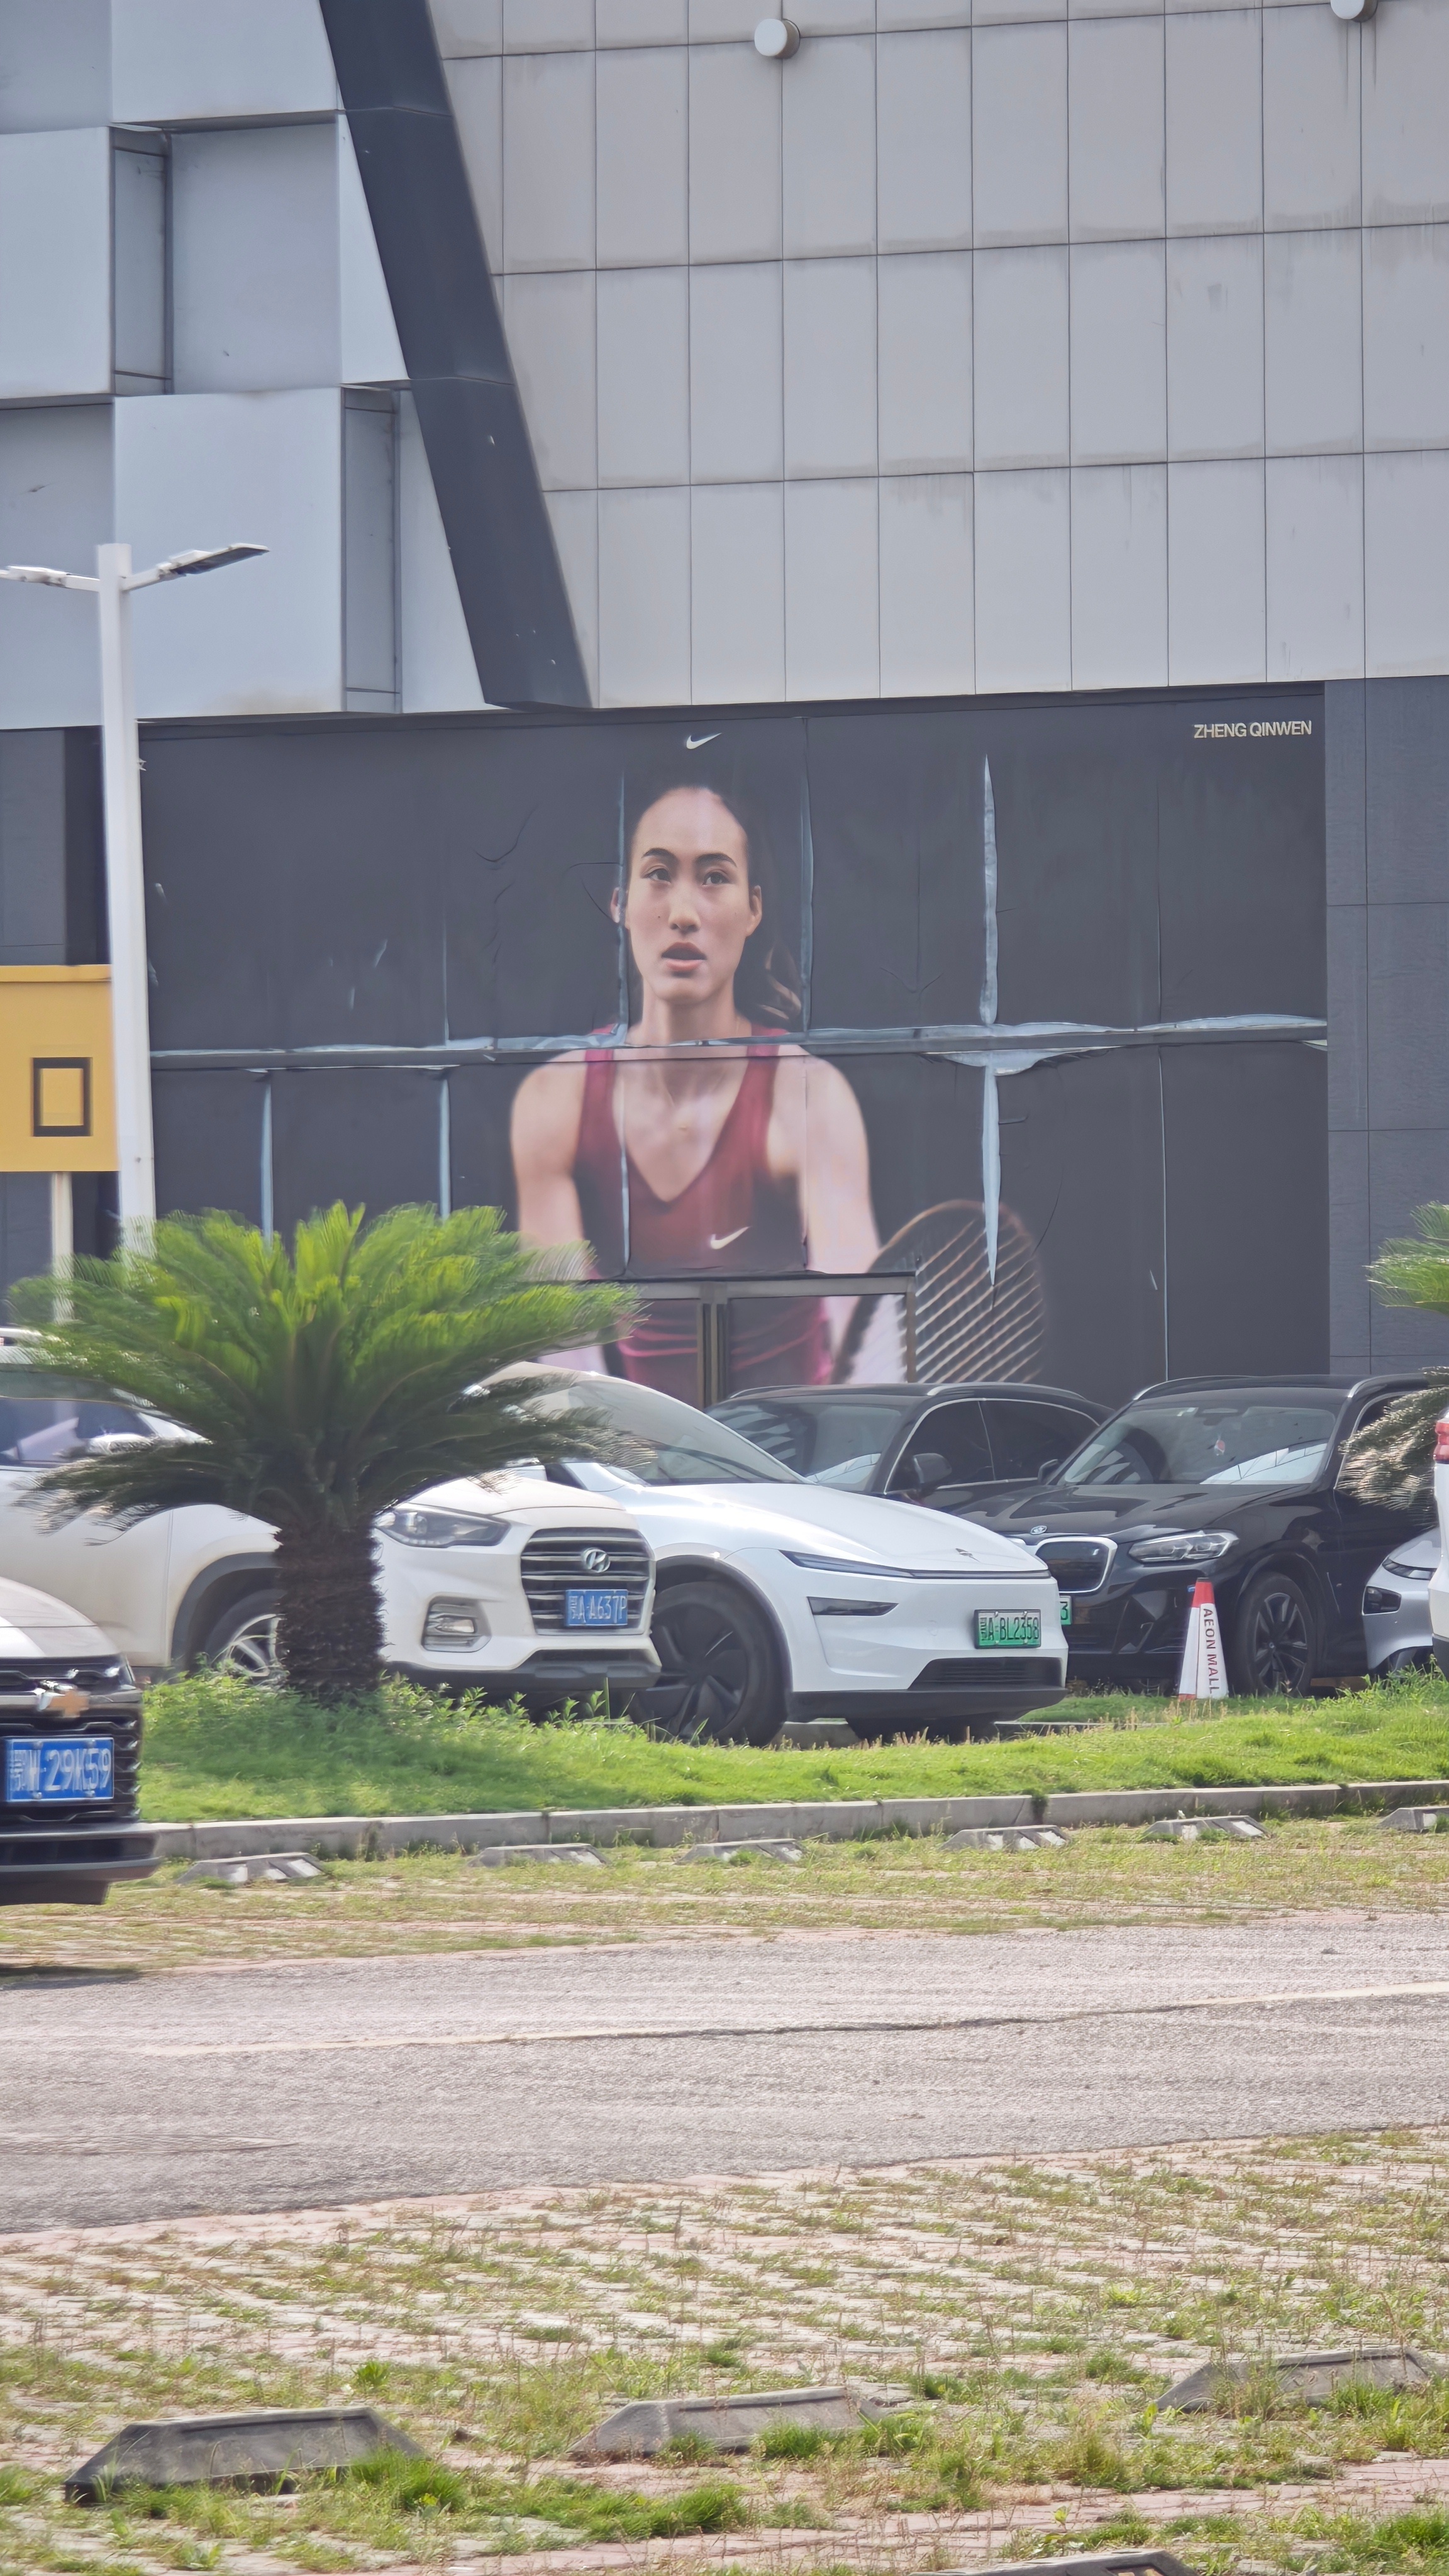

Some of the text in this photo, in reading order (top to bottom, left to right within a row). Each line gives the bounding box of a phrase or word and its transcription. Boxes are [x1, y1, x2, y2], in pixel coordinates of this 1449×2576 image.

[1194, 720, 1312, 738] ZHENG QINWEN
[1203, 1608, 1219, 1694] AEON MALL
